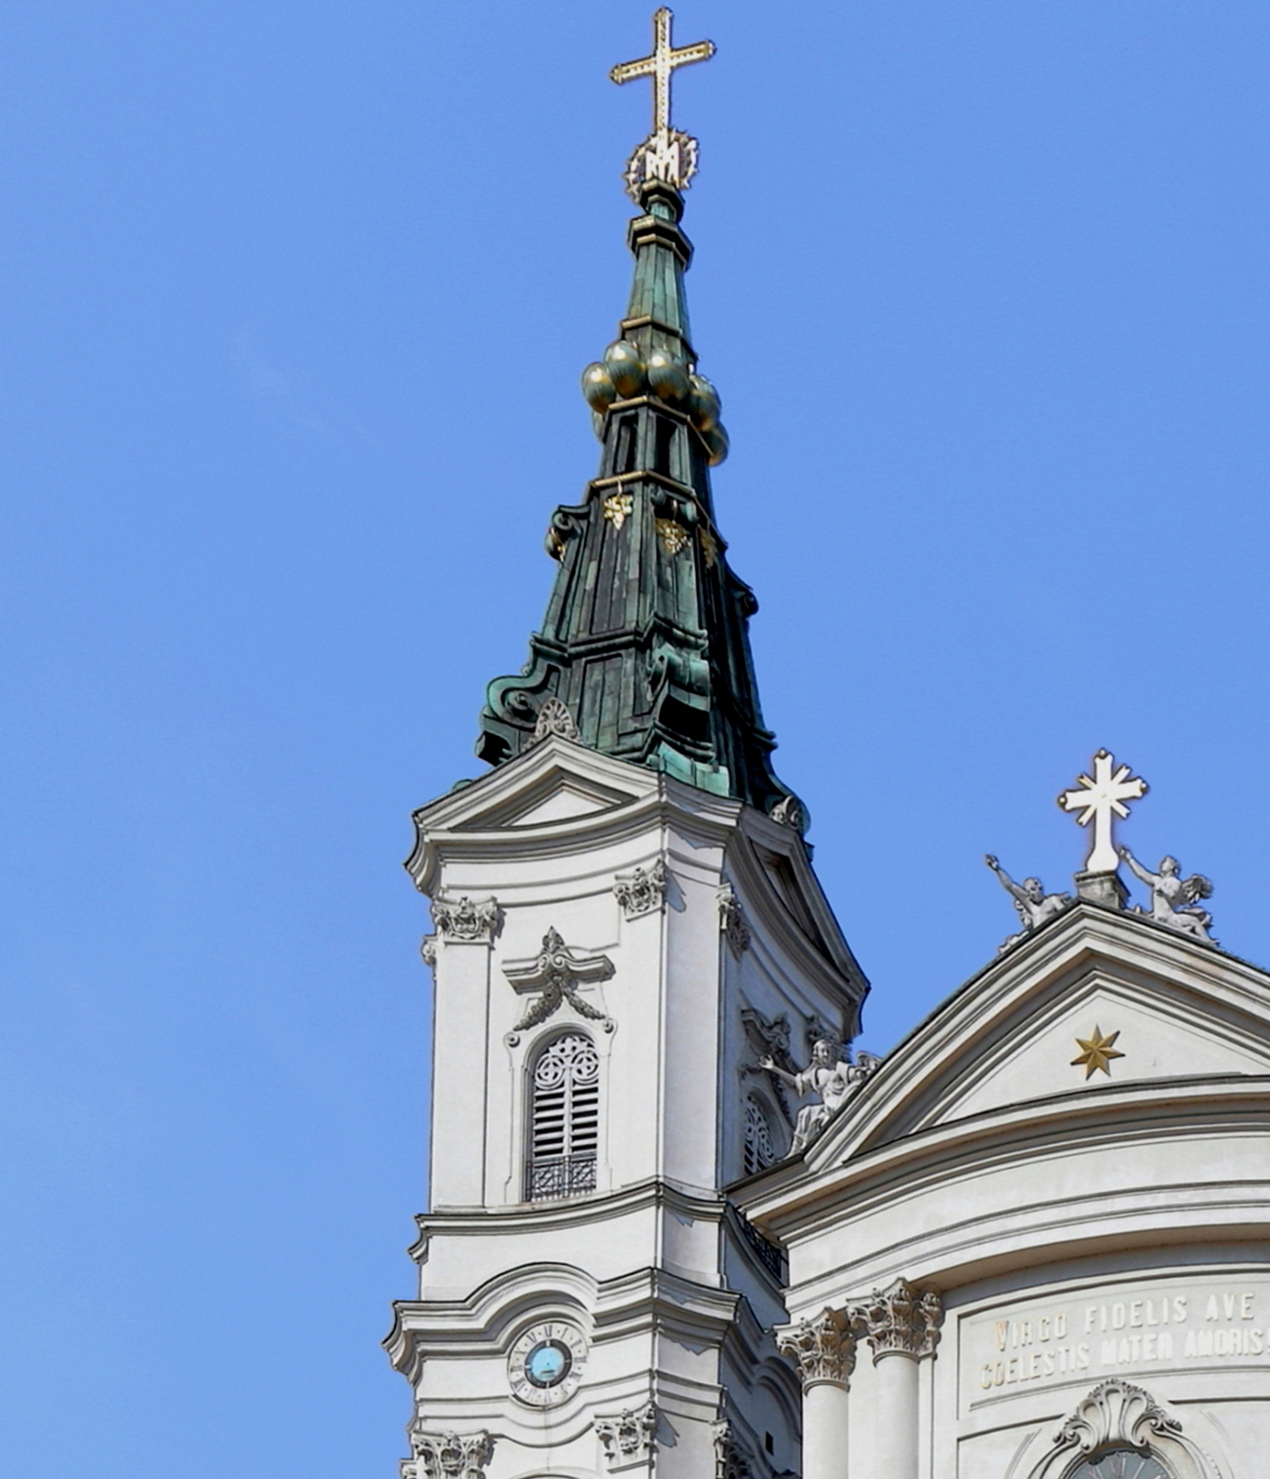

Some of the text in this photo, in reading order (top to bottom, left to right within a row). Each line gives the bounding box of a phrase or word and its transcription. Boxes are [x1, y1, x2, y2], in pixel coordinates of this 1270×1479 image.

[995, 1292, 1255, 1352] VIRGO FIDELIS AVE
[980, 1342, 1090, 1390] COELESTIS
[1101, 1332, 1174, 1367] MATER
